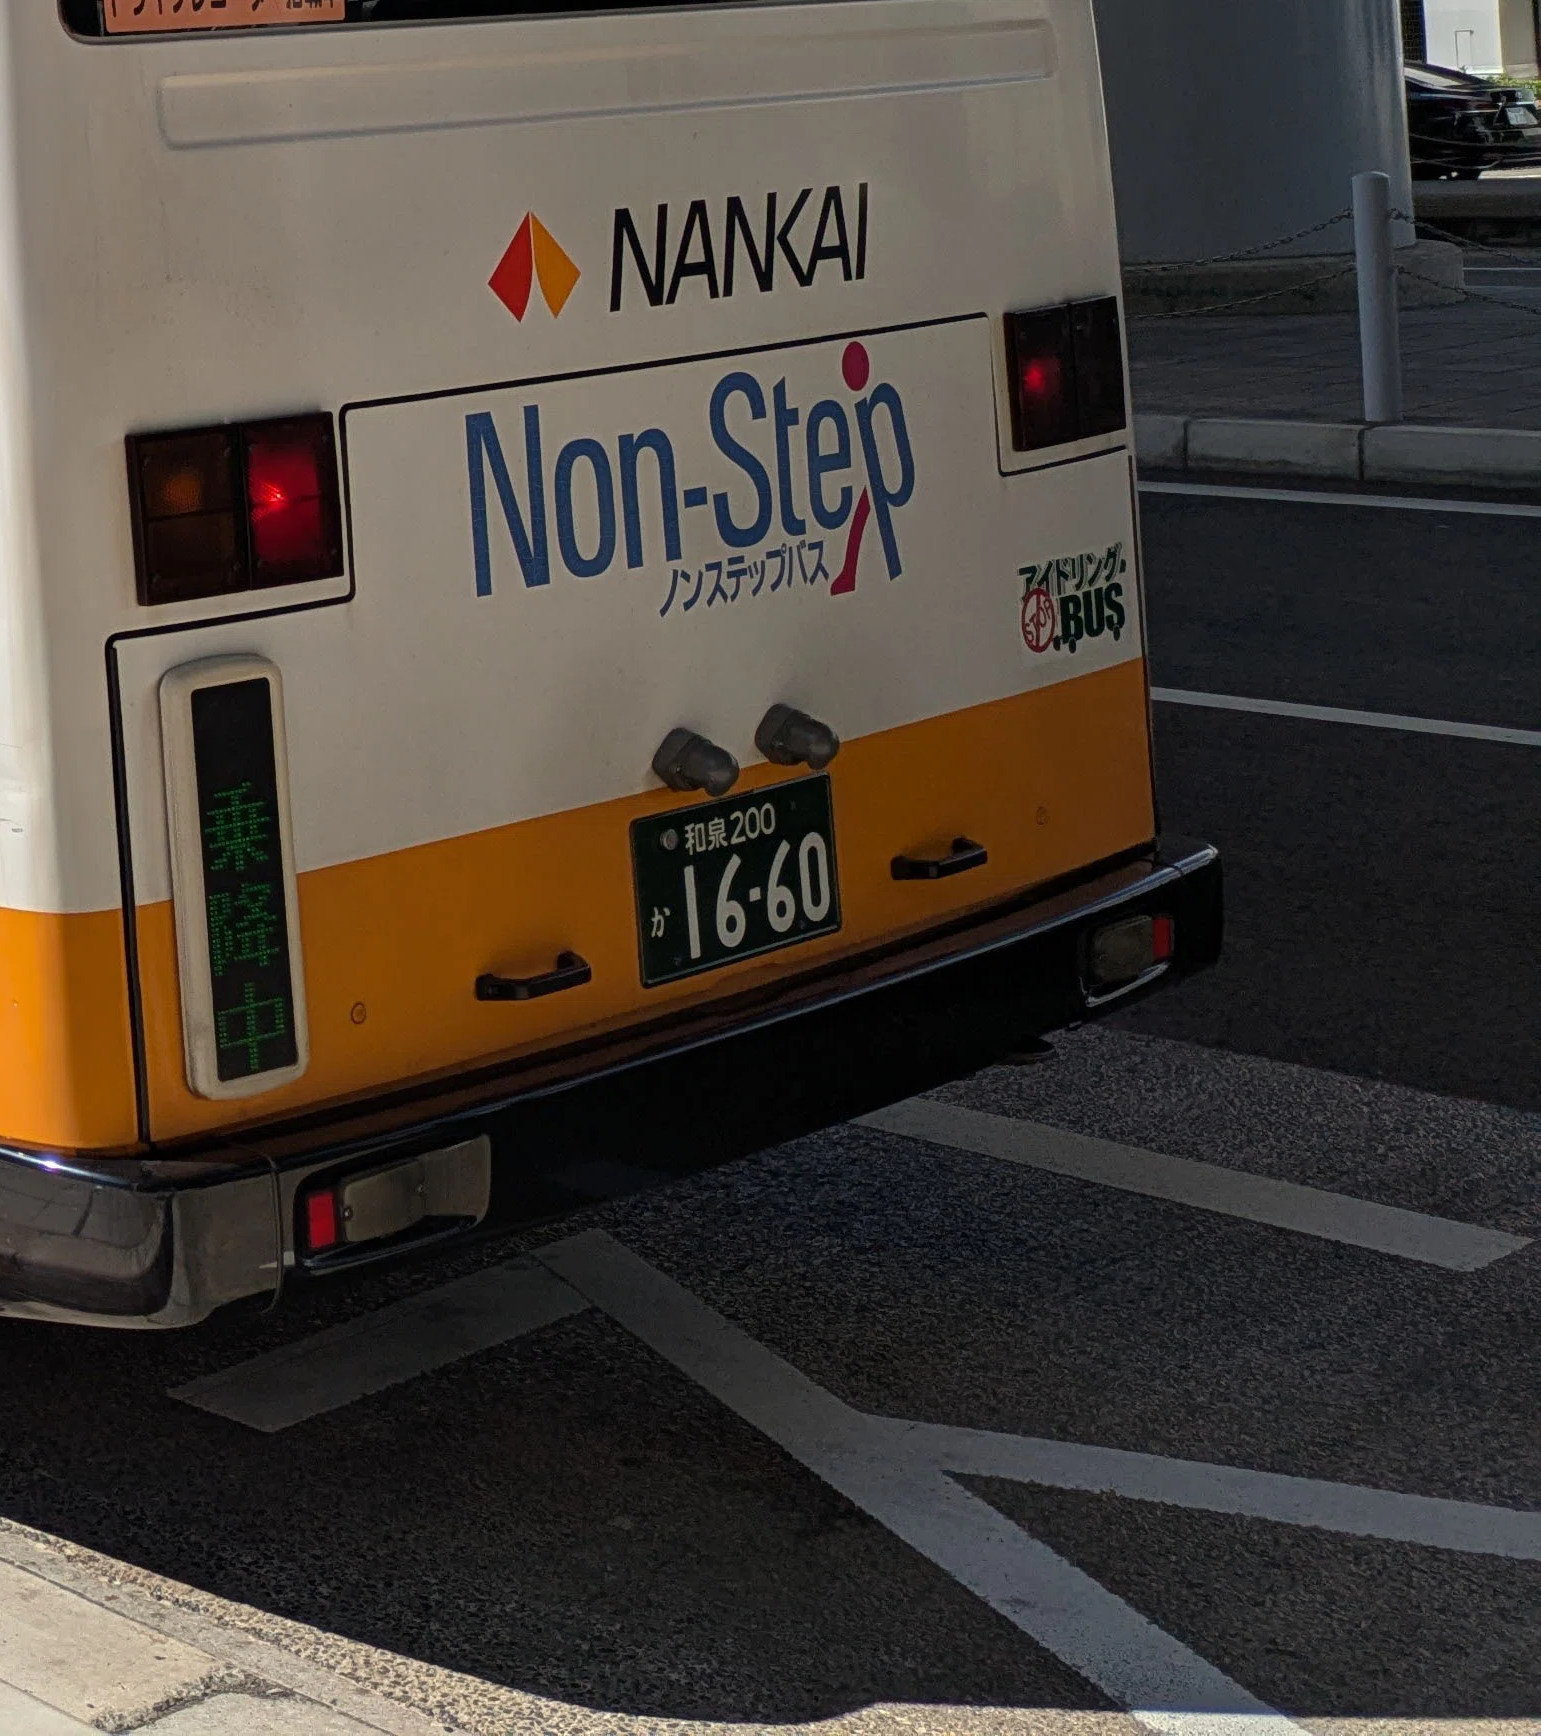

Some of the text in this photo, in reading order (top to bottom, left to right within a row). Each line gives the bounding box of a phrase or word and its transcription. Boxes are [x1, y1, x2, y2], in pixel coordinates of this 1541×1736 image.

[609, 181, 869, 313] NANKAI
[464, 368, 917, 598] Non-Step
[658, 538, 831, 618] ノンステップバス
[1059, 582, 1126, 645] BUS
[204, 780, 286, 1071] 乗降中
[650, 831, 831, 960] か 16-60
